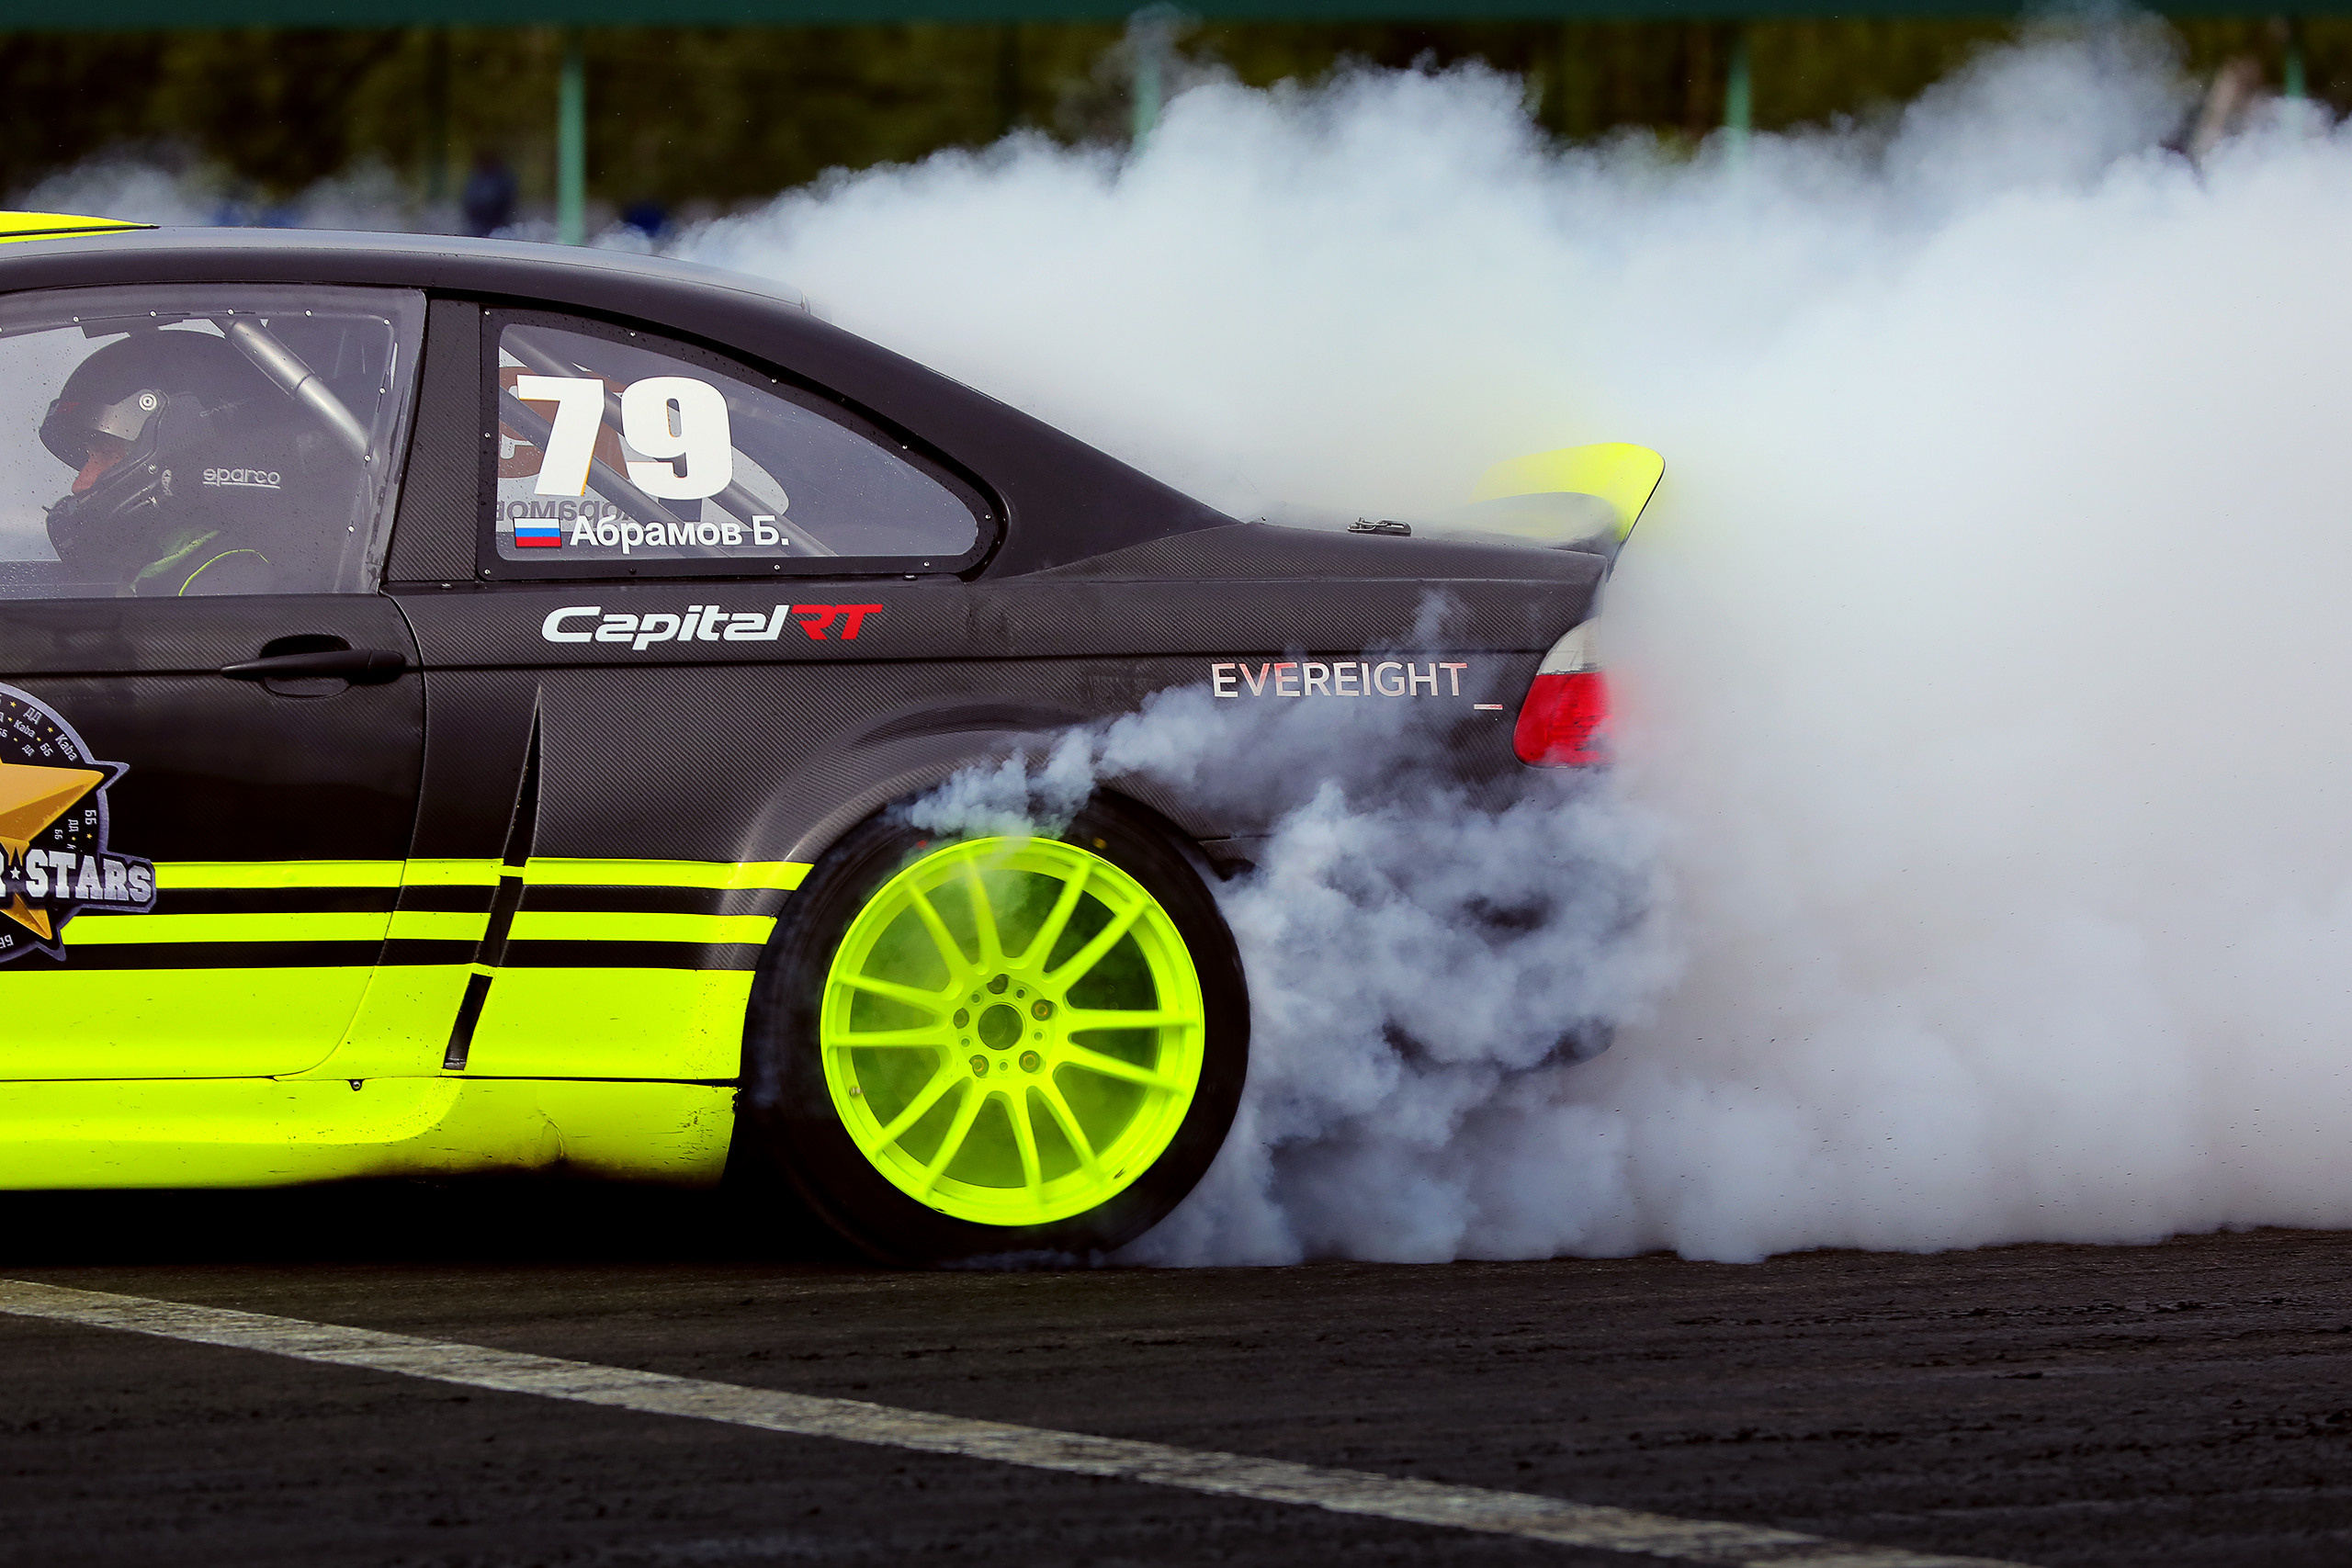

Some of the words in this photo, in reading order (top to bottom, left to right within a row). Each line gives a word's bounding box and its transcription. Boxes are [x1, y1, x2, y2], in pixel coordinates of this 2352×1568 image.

[516, 375, 733, 500] 79
[203, 468, 281, 489] sparco
[570, 514, 743, 554] Абрамов
[751, 514, 789, 547] Б.
[14, 719, 37, 739] Kaba
[55, 733, 78, 762] Kaba
[25, 849, 152, 902] STARS
